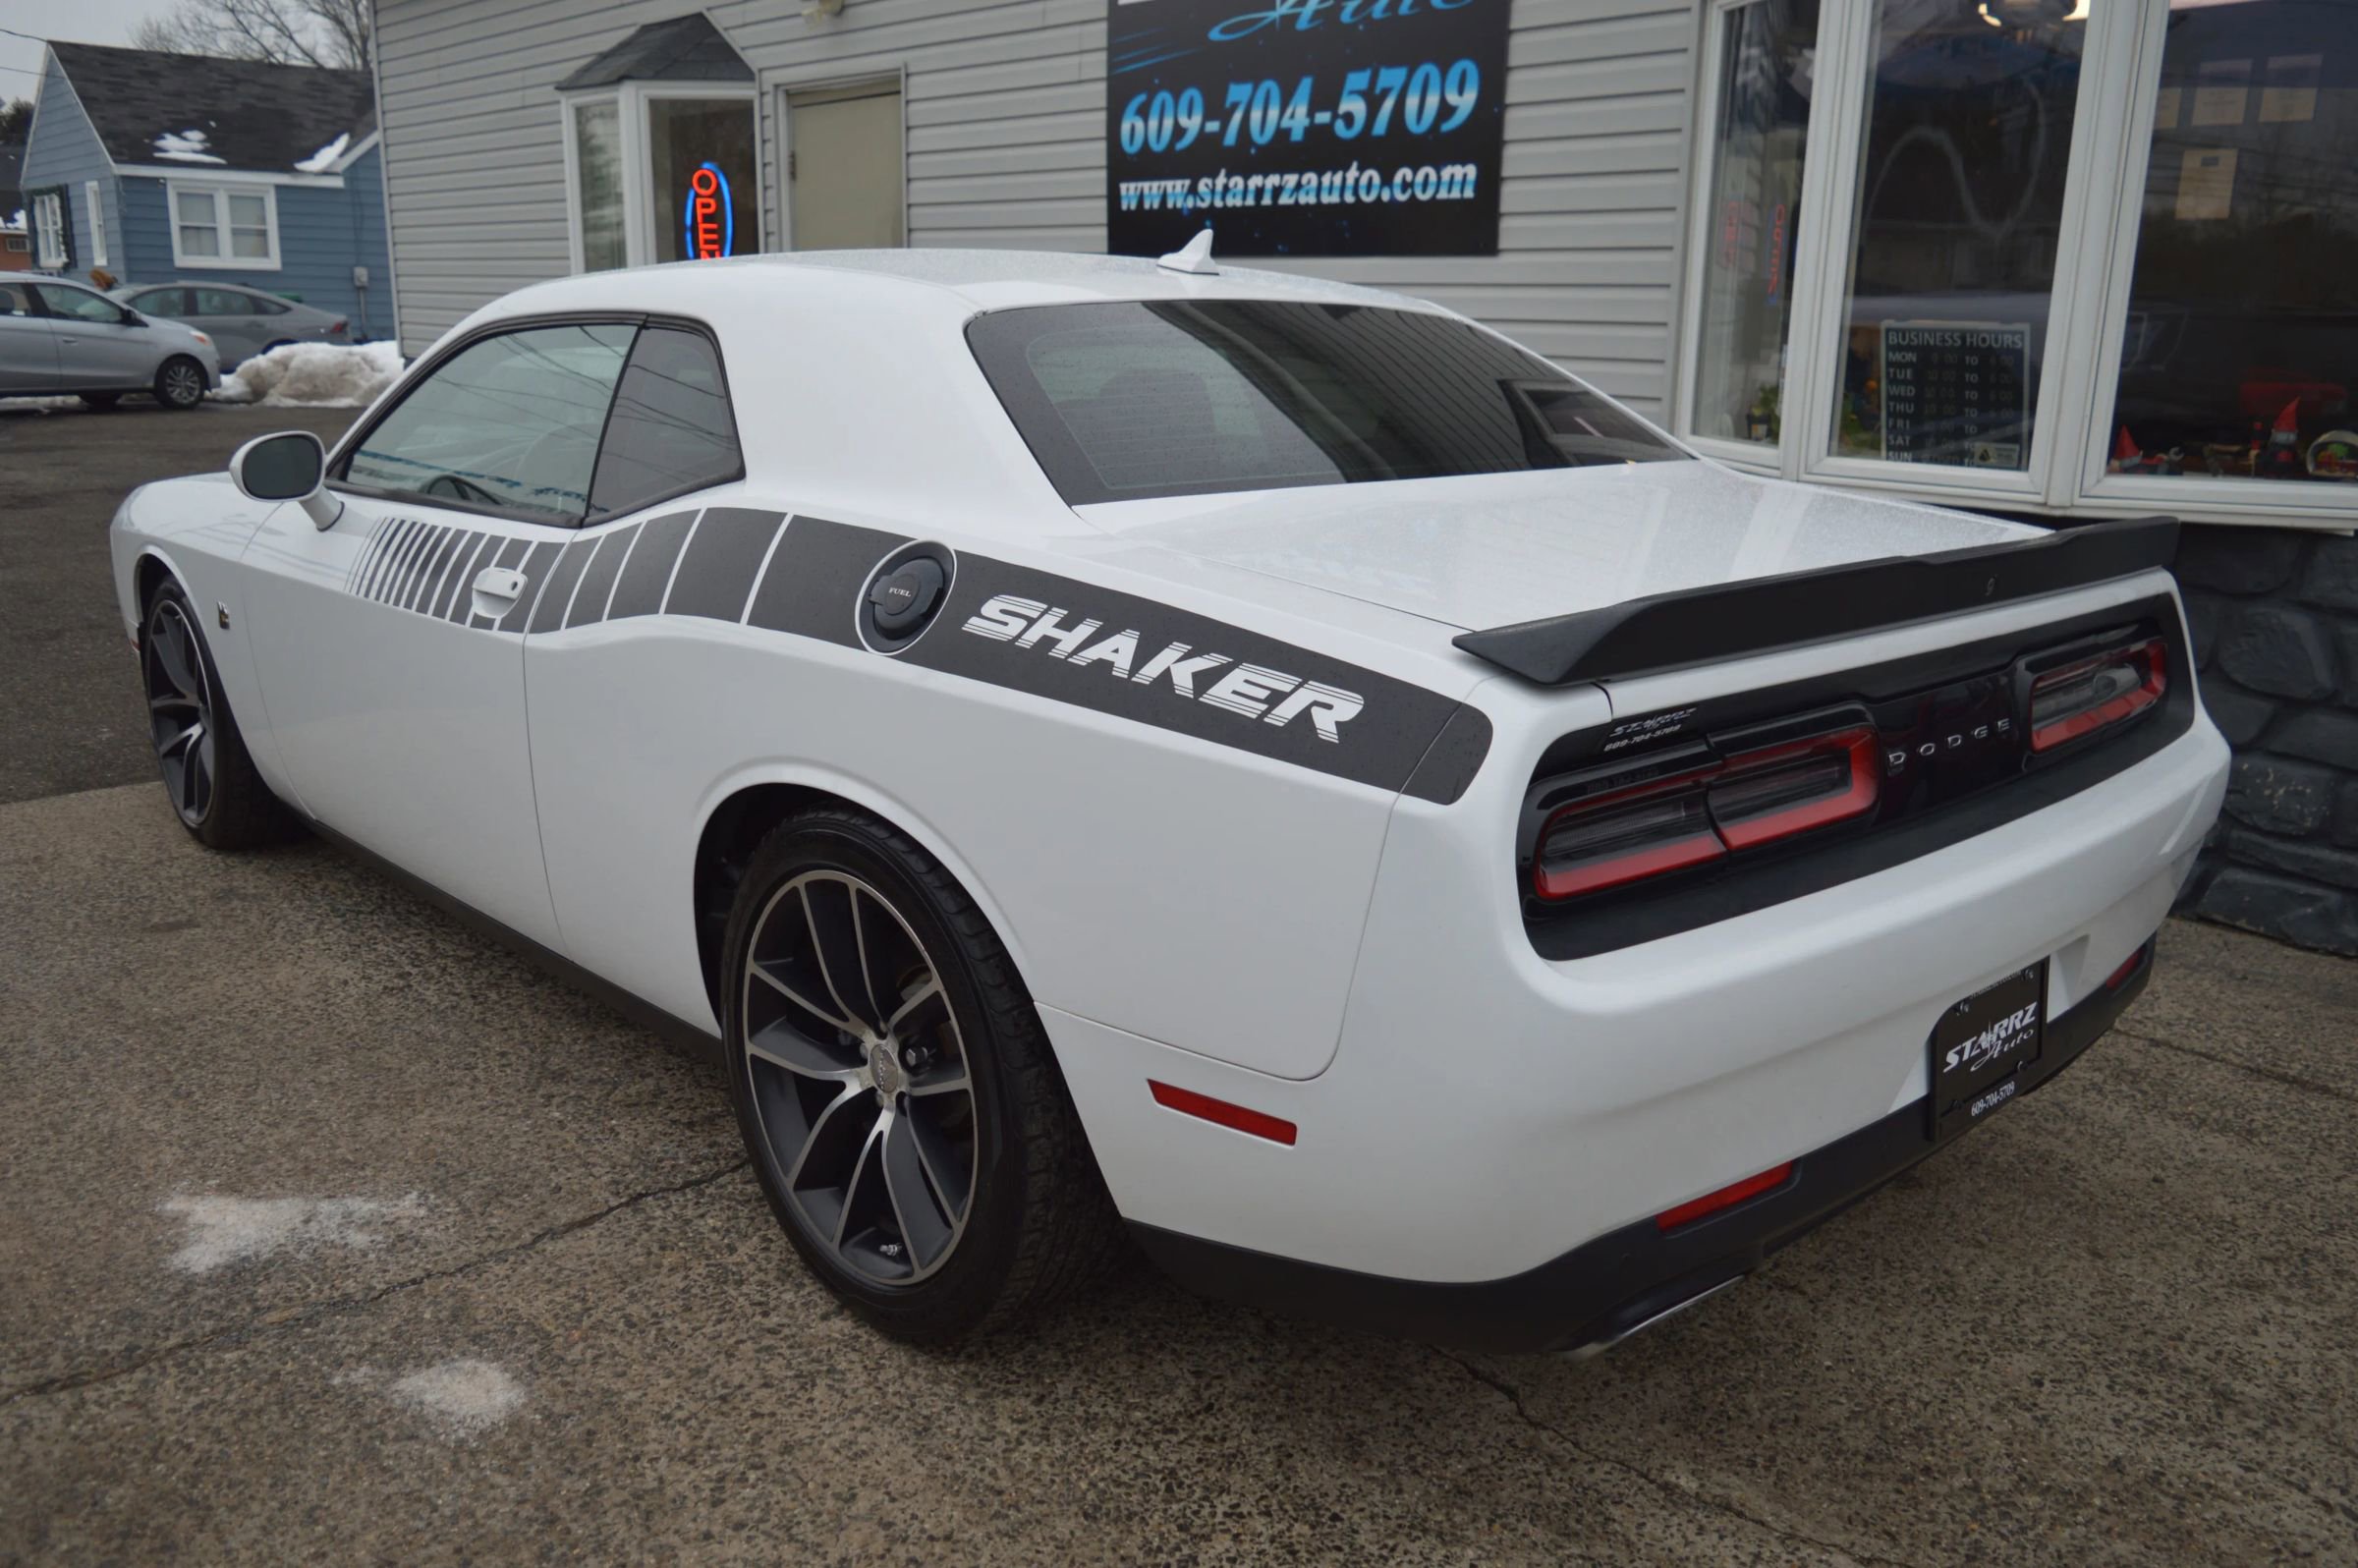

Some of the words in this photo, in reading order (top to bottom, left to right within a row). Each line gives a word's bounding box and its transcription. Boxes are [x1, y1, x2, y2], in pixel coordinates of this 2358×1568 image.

[1119, 59, 1480, 154] 609-704-5709
[1118, 160, 1478, 210] www.starrzauto.com
[1887, 331, 1962, 347] BUSINESS
[1965, 332, 2023, 349] HOURS
[1887, 352, 1917, 363] MON
[1965, 355, 1979, 365] TO
[1887, 367, 1913, 380] TUE
[1965, 372, 1979, 383] TO
[1887, 385, 1916, 397] WED
[1965, 390, 1978, 401] TO
[1887, 402, 1915, 414] THU
[1964, 408, 1978, 418] TO
[1888, 419, 1910, 430] FRI
[1964, 424, 1978, 434] TO
[1887, 434, 1910, 446] SAT
[888, 587, 912, 597] FUEL
[960, 592, 1366, 745] SHAKER
[1888, 718, 2010, 764] DODGE
[1942, 1001, 2039, 1073] STARRZ
[1970, 1028, 2035, 1072] Auto
[1971, 1081, 2015, 1117] 609-704-5709
